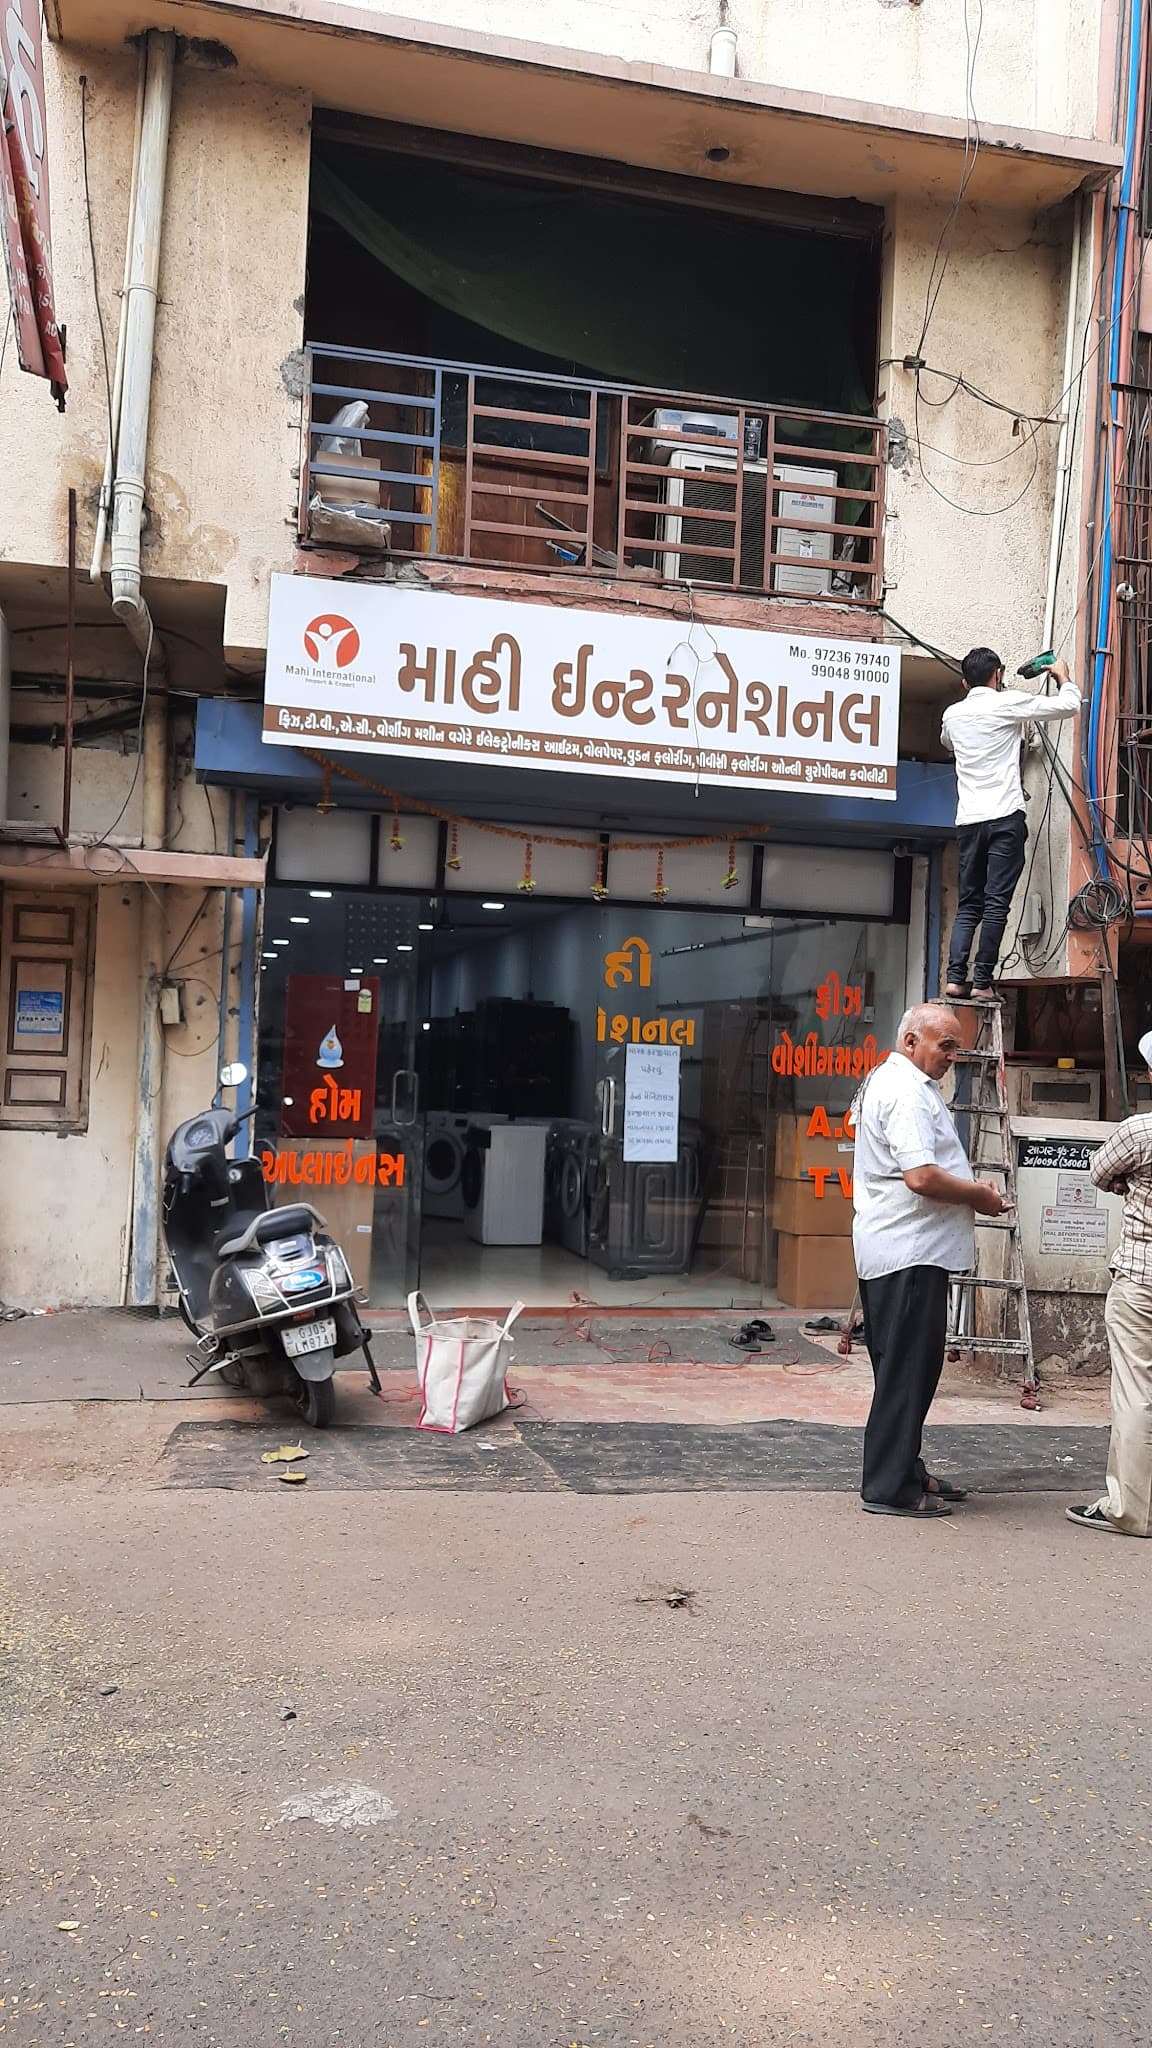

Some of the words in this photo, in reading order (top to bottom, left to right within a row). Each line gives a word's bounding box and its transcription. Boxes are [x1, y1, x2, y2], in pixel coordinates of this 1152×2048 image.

[789, 645, 811, 660] Mo.
[814, 648, 851, 664] 97236
[855, 653, 890, 668] 79740
[286, 665, 309, 676] Mahi
[312, 668, 376, 684] International
[811, 664, 850, 680] 99048
[853, 668, 889, 684] 91000
[398, 632, 522, 715] માહી
[551, 644, 881, 747] ઈન્ટરનેશનલ
[414, 725, 445, 743] મશીન
[309, 1073, 362, 1124] હોમ
